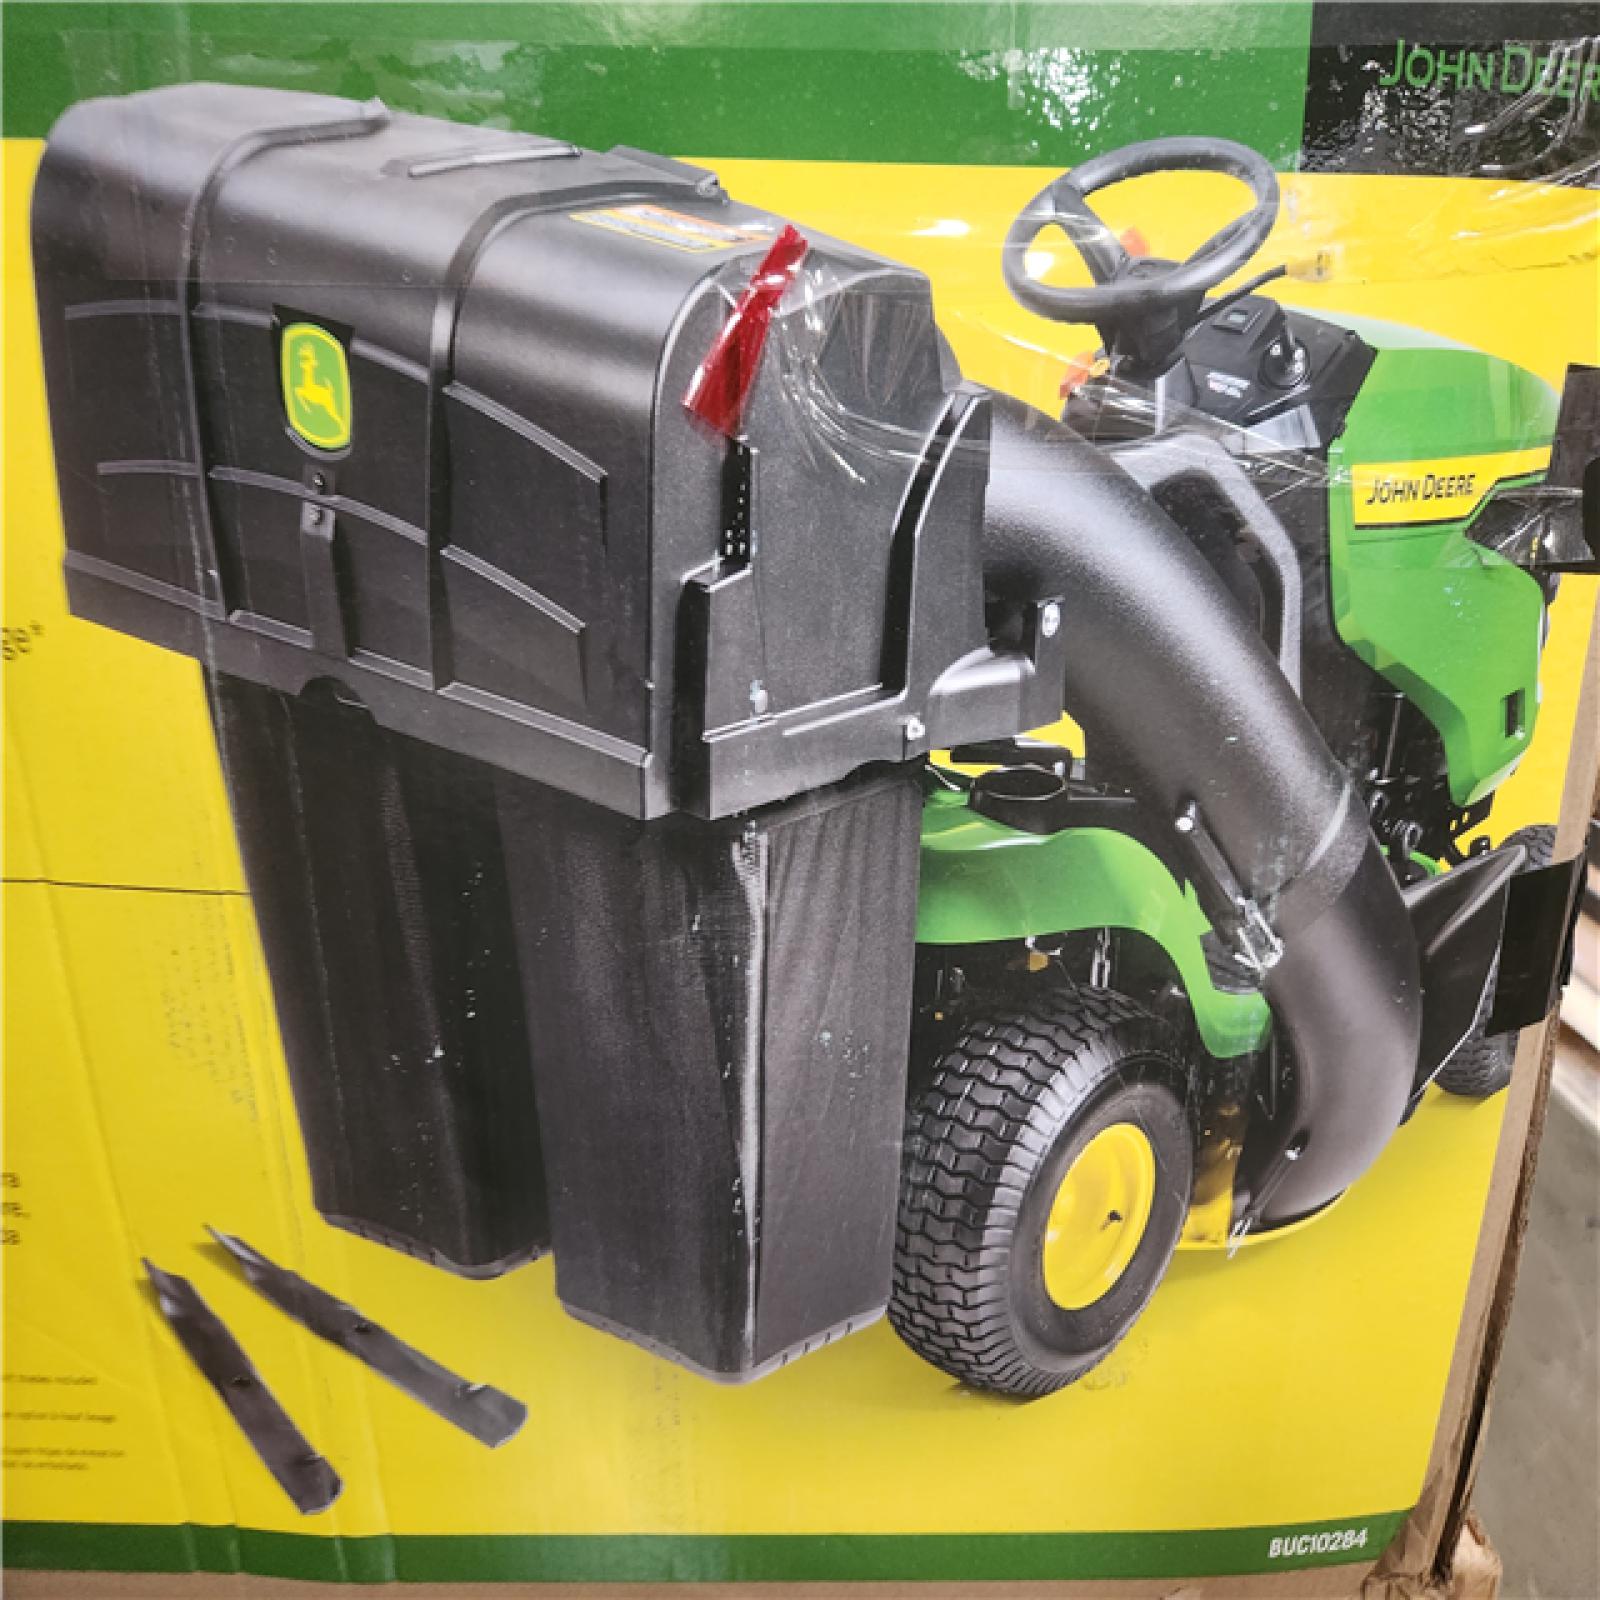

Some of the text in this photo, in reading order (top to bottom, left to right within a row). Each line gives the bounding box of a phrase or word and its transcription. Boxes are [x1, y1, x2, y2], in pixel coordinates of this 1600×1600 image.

[1379, 39, 1496, 92] JOHN
[1366, 474, 1476, 505] JOHN DEERE
[1267, 1527, 1369, 1558] BUC10284
